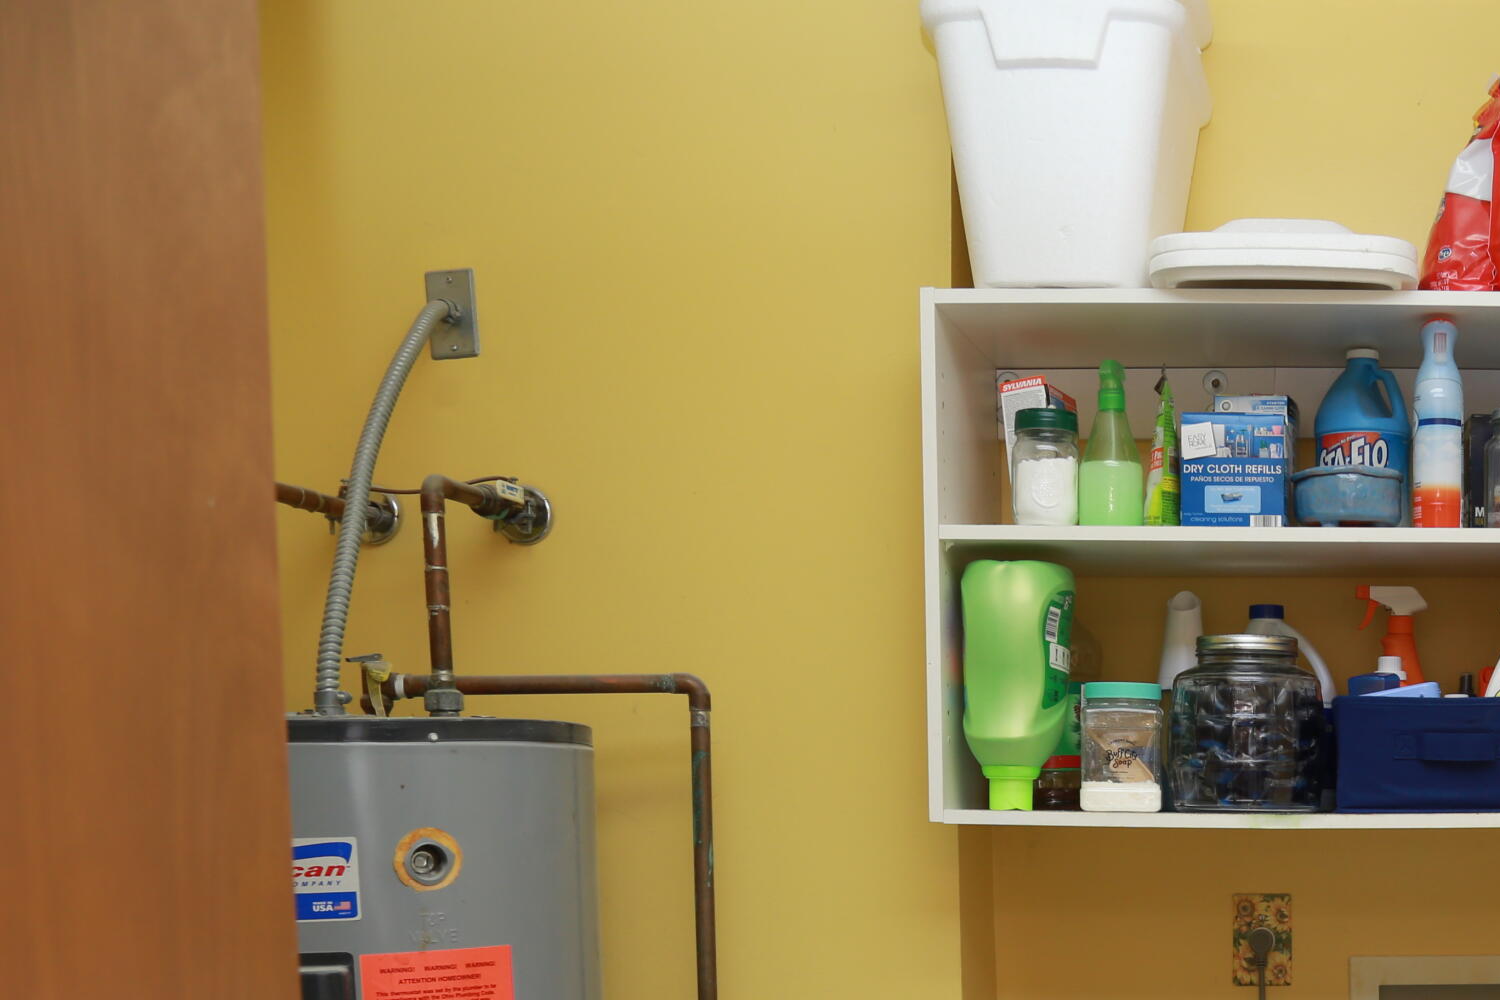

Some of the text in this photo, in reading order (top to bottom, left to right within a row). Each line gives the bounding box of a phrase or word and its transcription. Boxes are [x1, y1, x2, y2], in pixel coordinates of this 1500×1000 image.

[1003, 378, 1042, 391] SYLVANIA
[1183, 464, 1282, 474] DRY CLOTH REFILLS
[1105, 748, 1138, 761] Buff City
[1113, 759, 1132, 768] Soap
[312, 904, 334, 912] USA
[398, 977, 436, 985] ATTENTION
